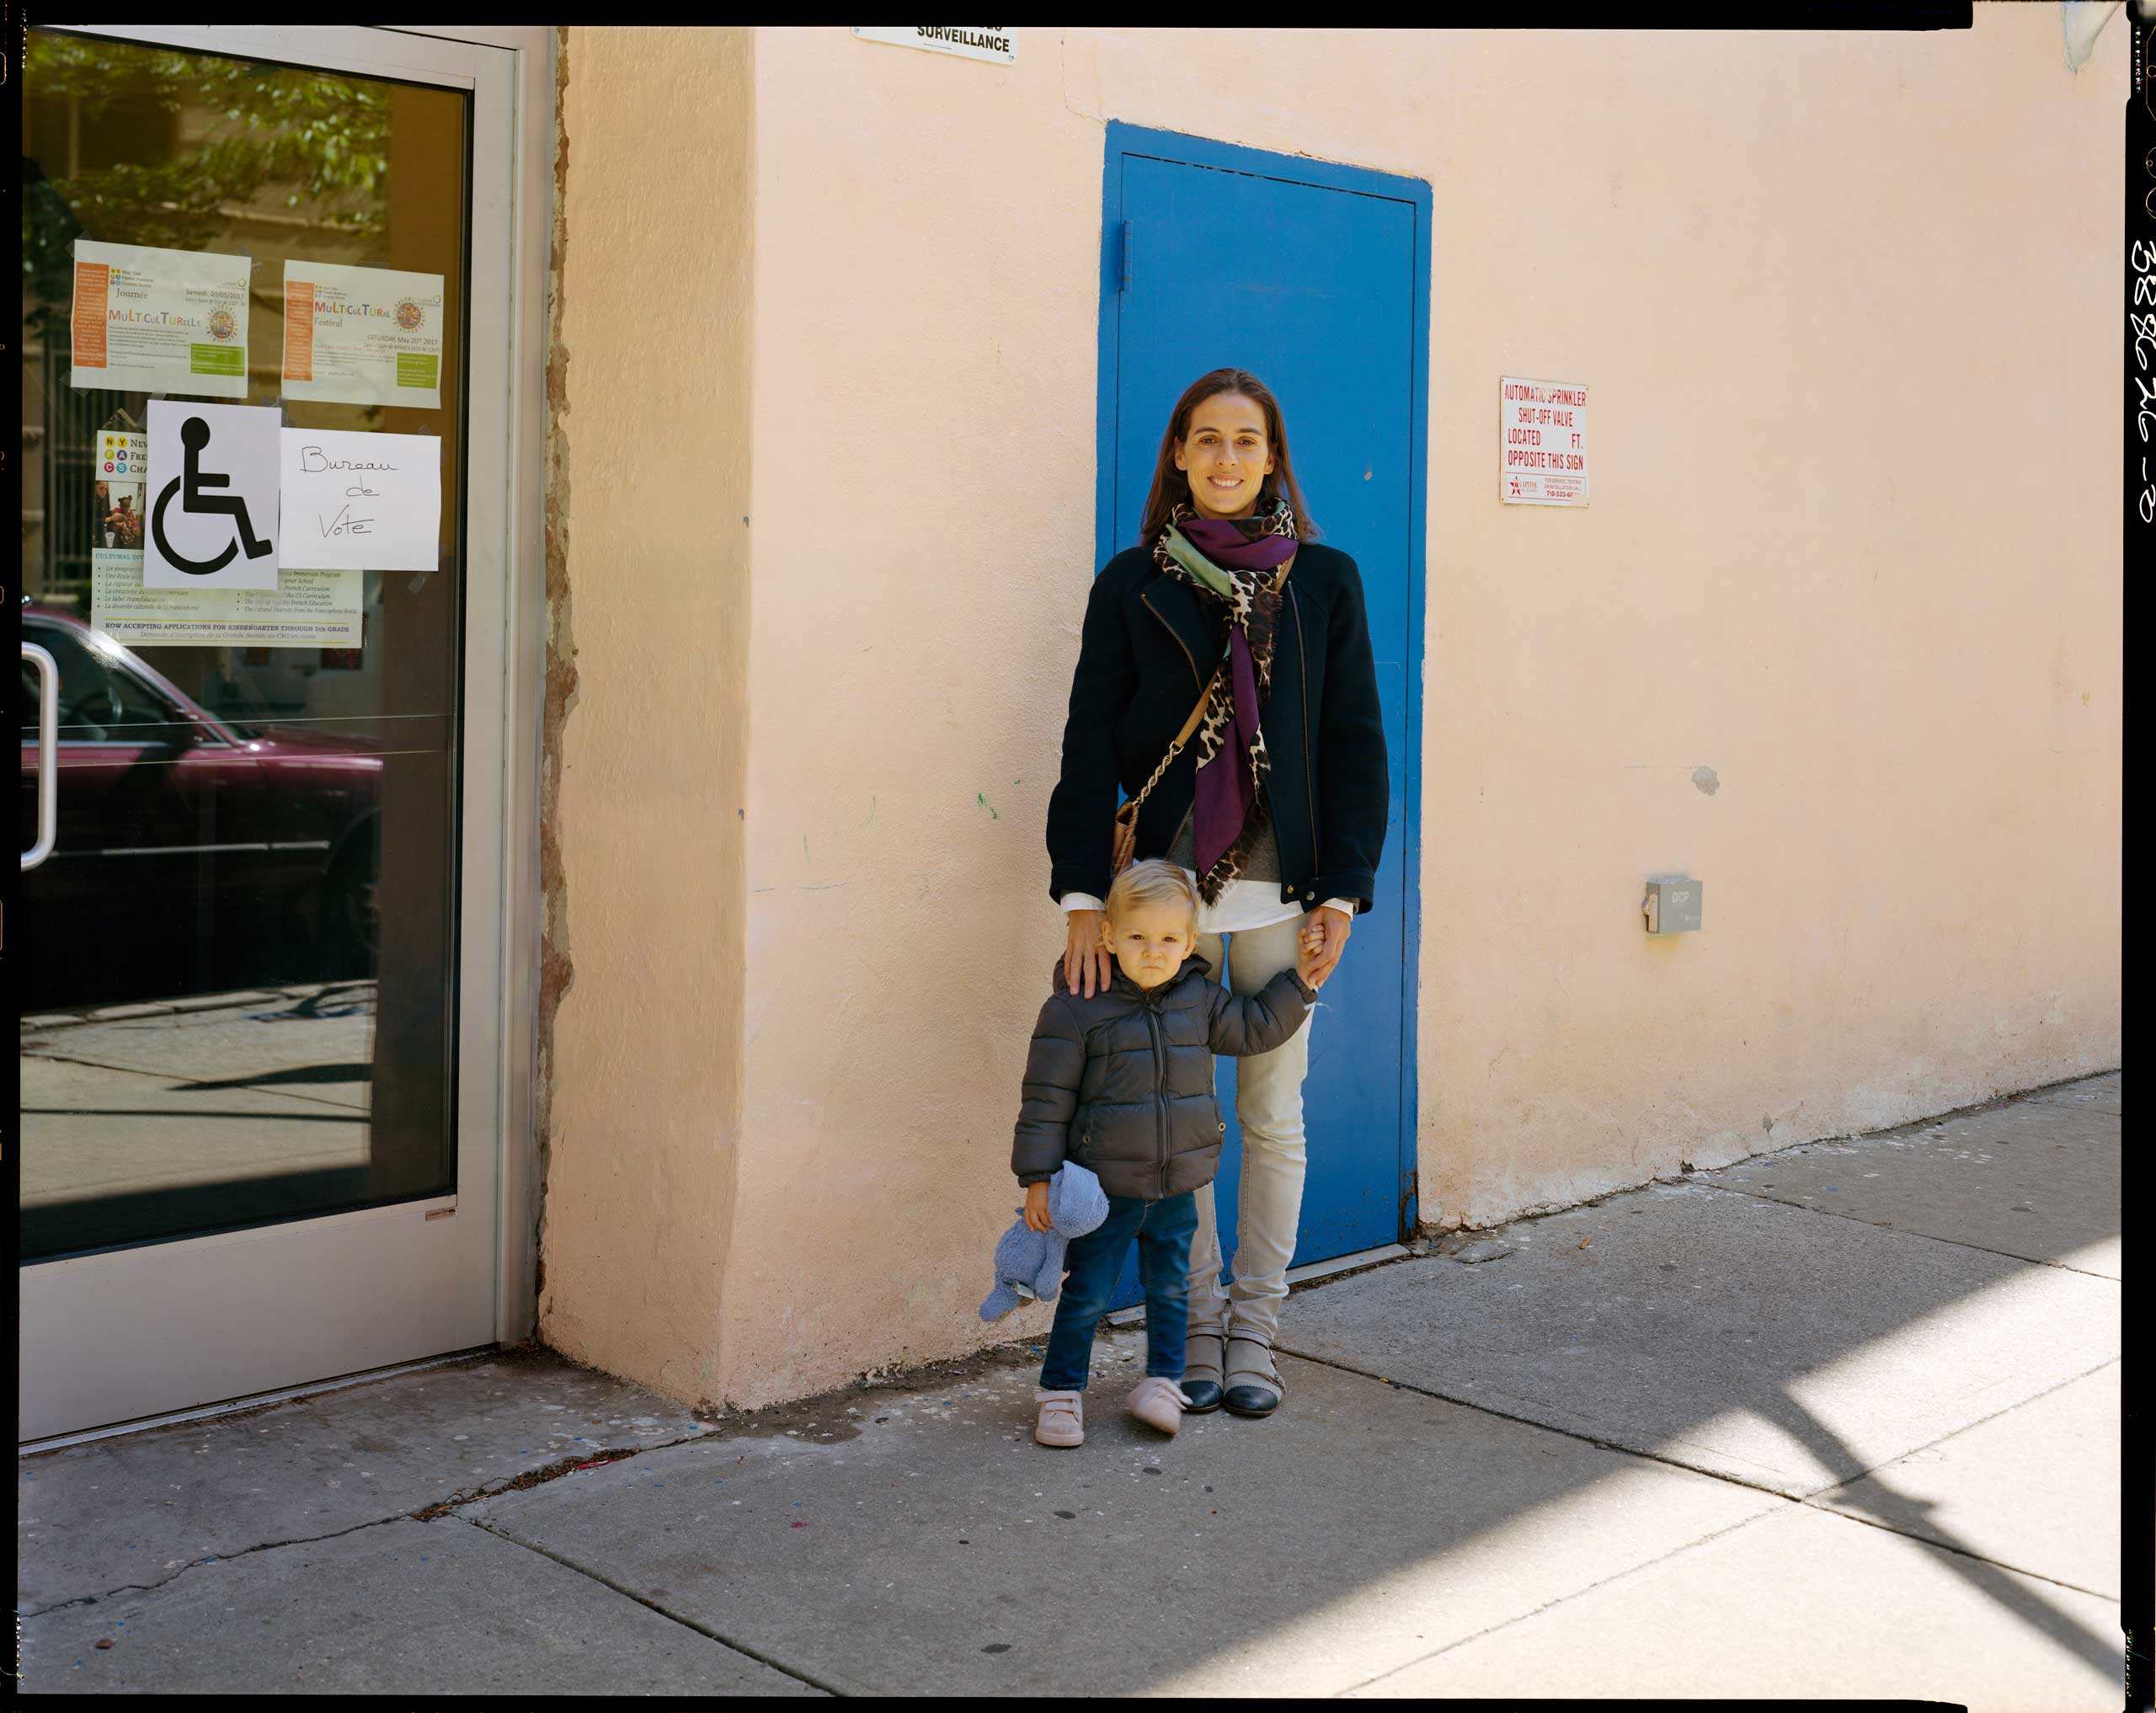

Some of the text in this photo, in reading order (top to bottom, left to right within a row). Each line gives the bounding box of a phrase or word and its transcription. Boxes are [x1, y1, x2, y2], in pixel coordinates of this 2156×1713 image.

[917, 26, 1010, 52] SURVEILLANCE
[116, 288, 148, 299] Journée
[314, 319, 343, 328] Festival
[1505, 384, 1587, 408] AUTOMATIC SPRINKLER
[1518, 407, 1573, 427] SHUT-OFF VALVE
[1508, 428, 1583, 449] LOCATED FT.
[131, 452, 147, 461] FRE
[299, 446, 398, 473] Bureau
[1508, 450, 1583, 470] OPPOSITE THIS SIGN
[345, 475, 380, 497] de
[318, 504, 376, 538] Vote
